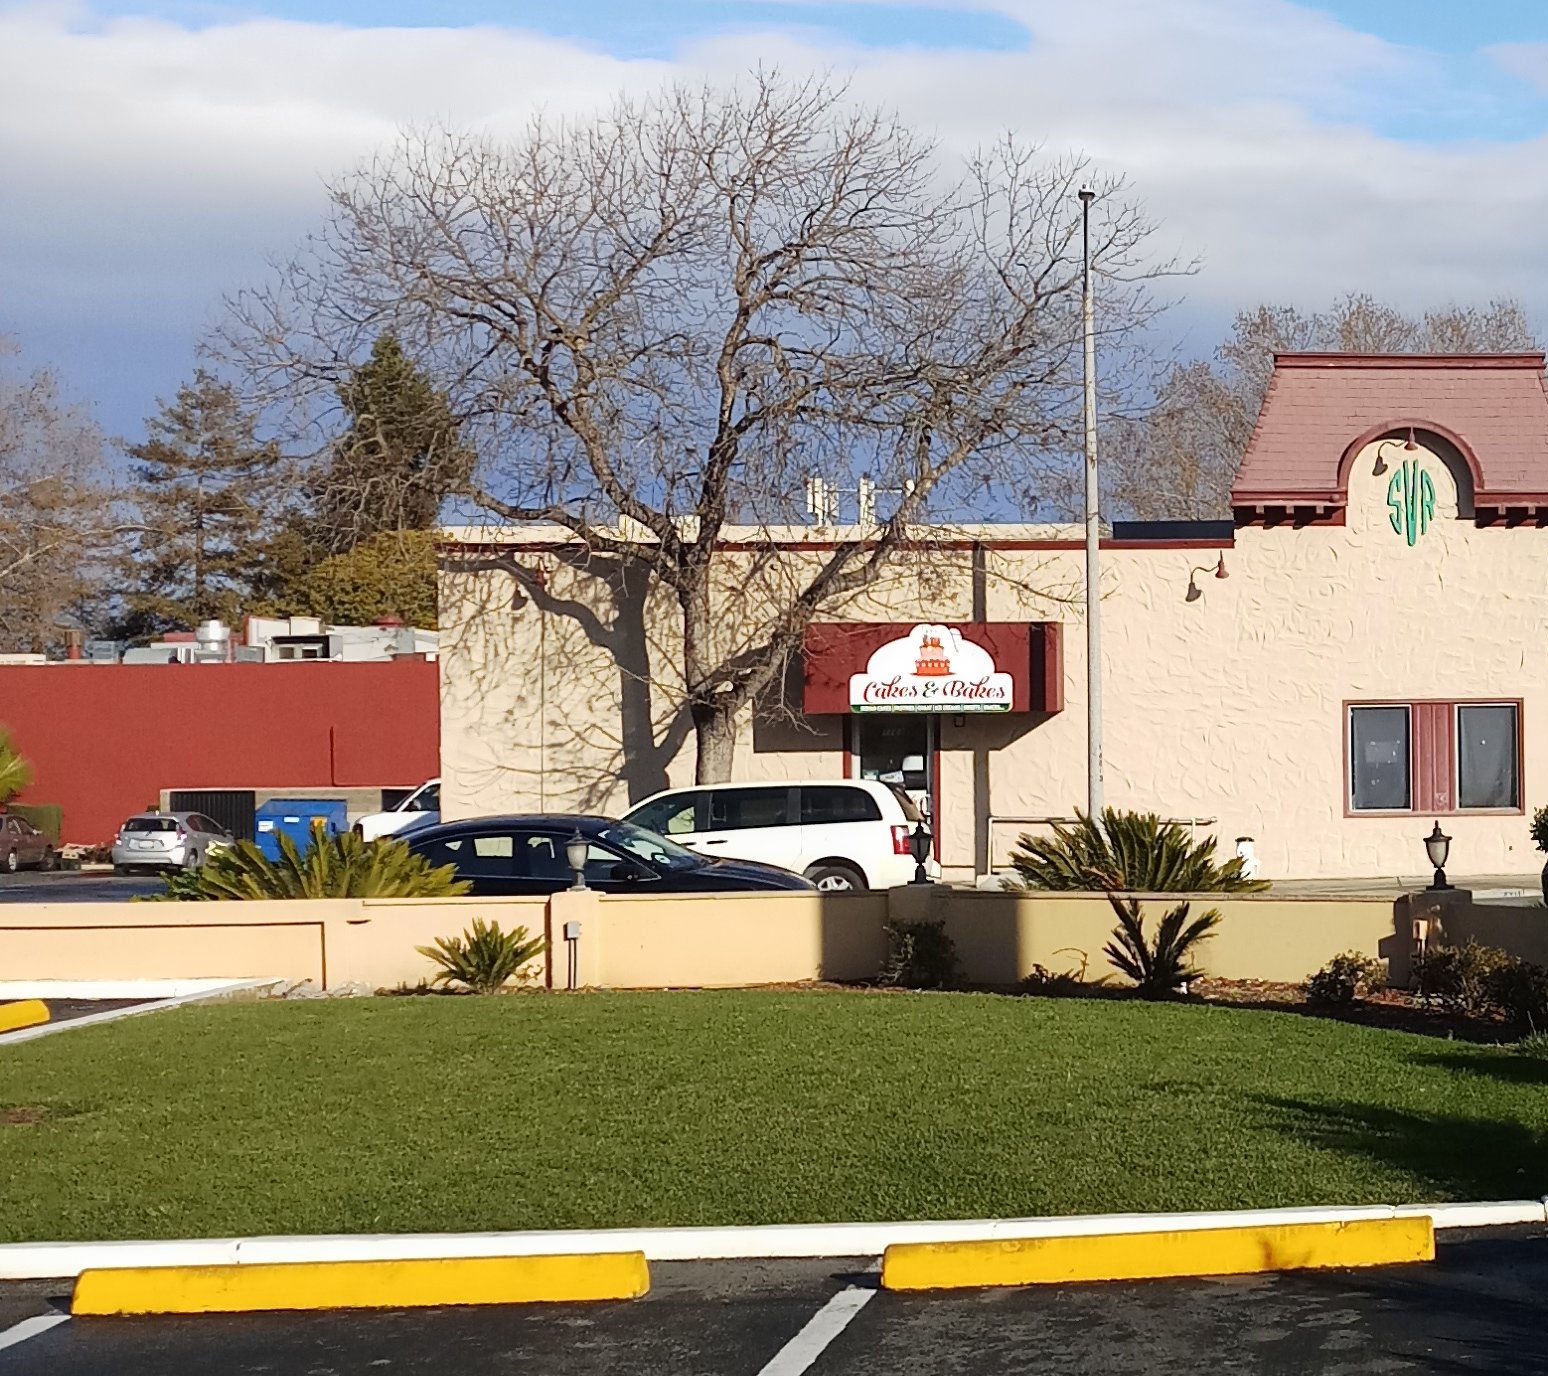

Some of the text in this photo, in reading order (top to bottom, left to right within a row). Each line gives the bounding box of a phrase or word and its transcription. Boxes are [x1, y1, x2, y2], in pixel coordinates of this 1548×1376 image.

[863, 675, 1006, 703] Cakes & Bakes
